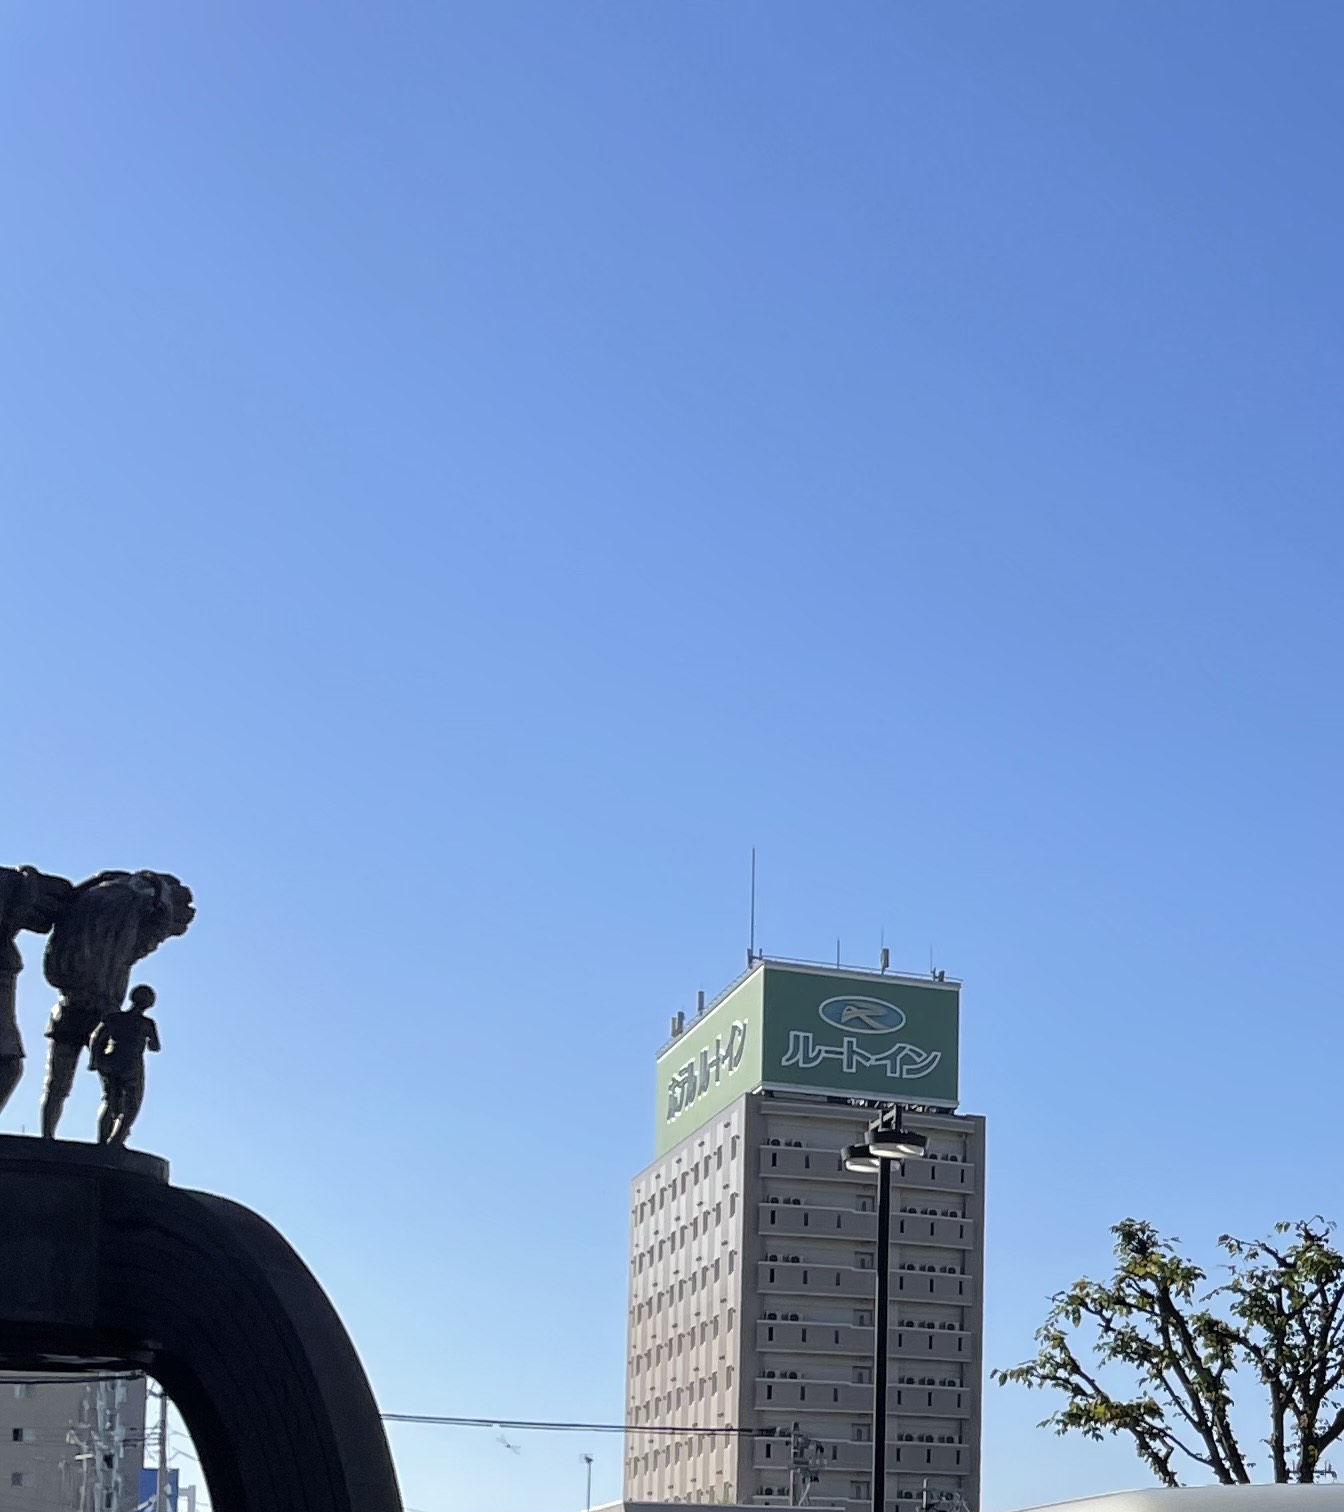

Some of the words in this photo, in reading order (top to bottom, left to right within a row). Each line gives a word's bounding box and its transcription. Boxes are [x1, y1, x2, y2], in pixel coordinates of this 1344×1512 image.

[781, 1031, 942, 1079] ルートイン
